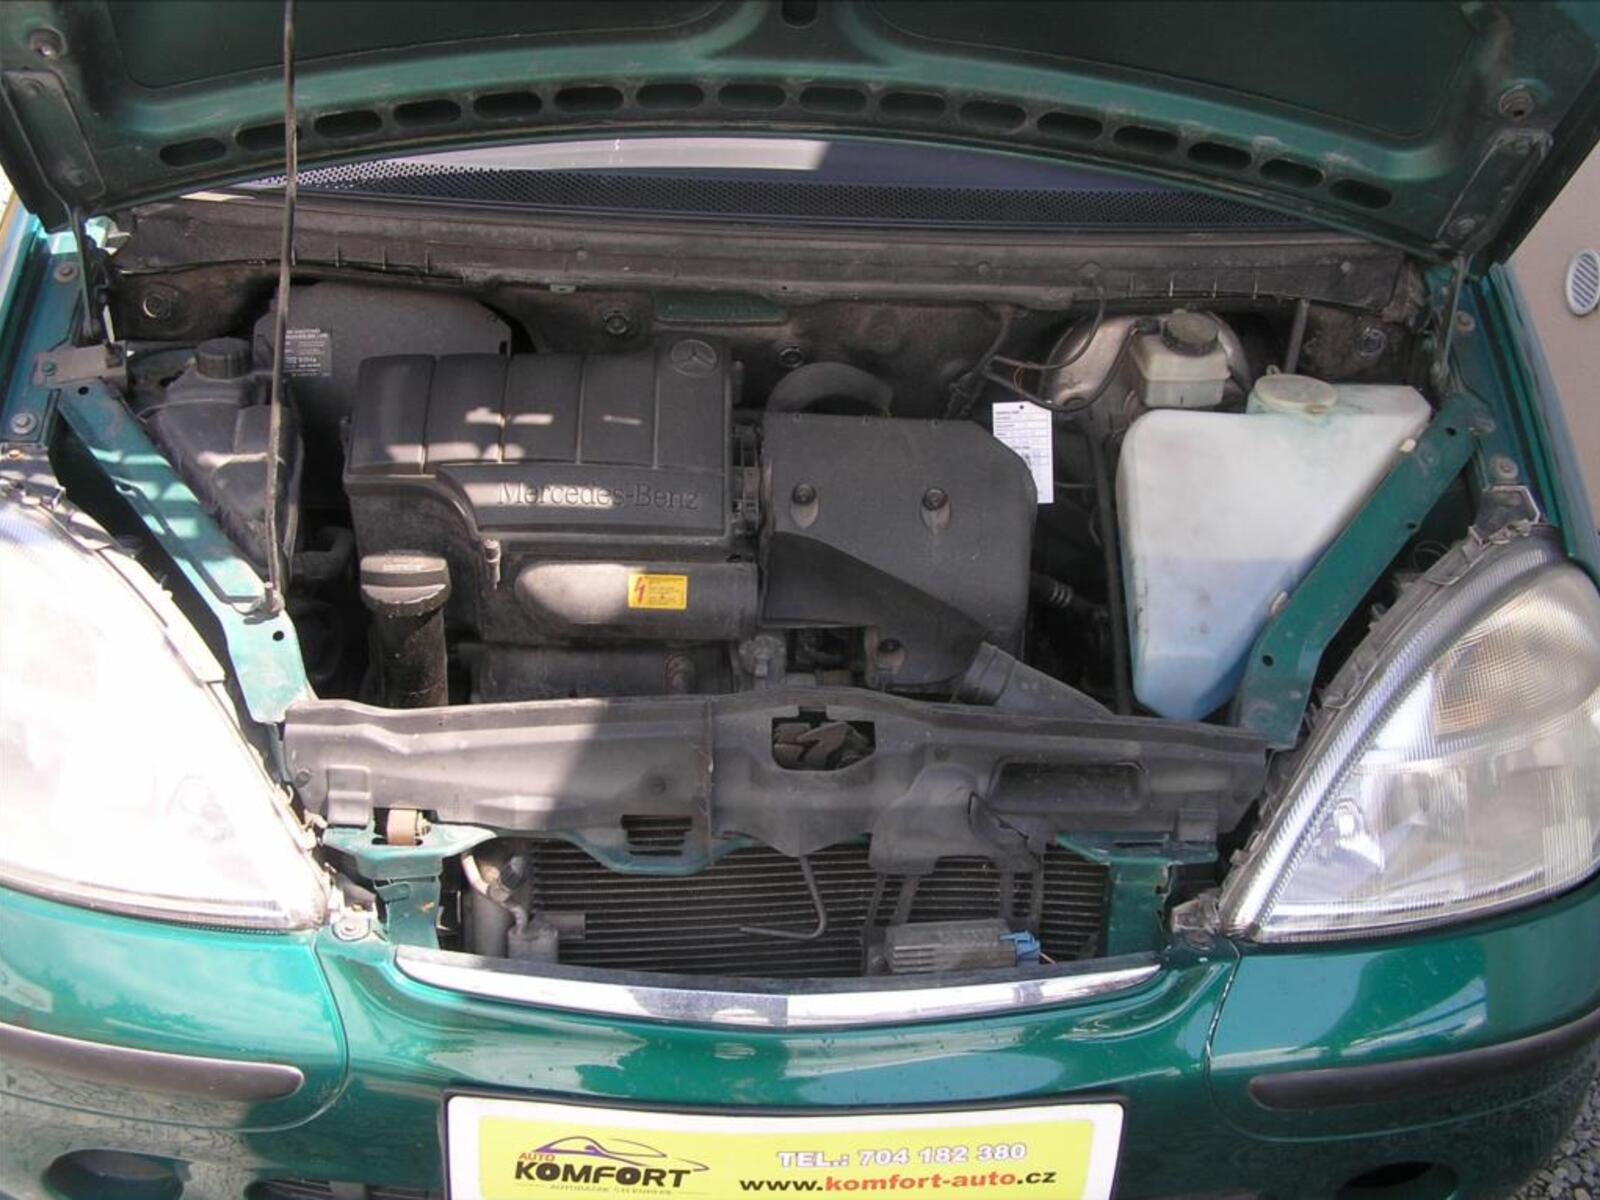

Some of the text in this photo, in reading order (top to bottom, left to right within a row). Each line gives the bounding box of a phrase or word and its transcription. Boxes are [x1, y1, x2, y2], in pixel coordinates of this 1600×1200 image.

[498, 480, 698, 510] Mercedes-Benz
[518, 1152, 556, 1162] AUTO
[777, 1143, 1027, 1168] TEL.: 704 182 380
[515, 1161, 691, 1187] KOMFORT
[739, 1171, 1057, 1192] www.komfort-auto.cz
